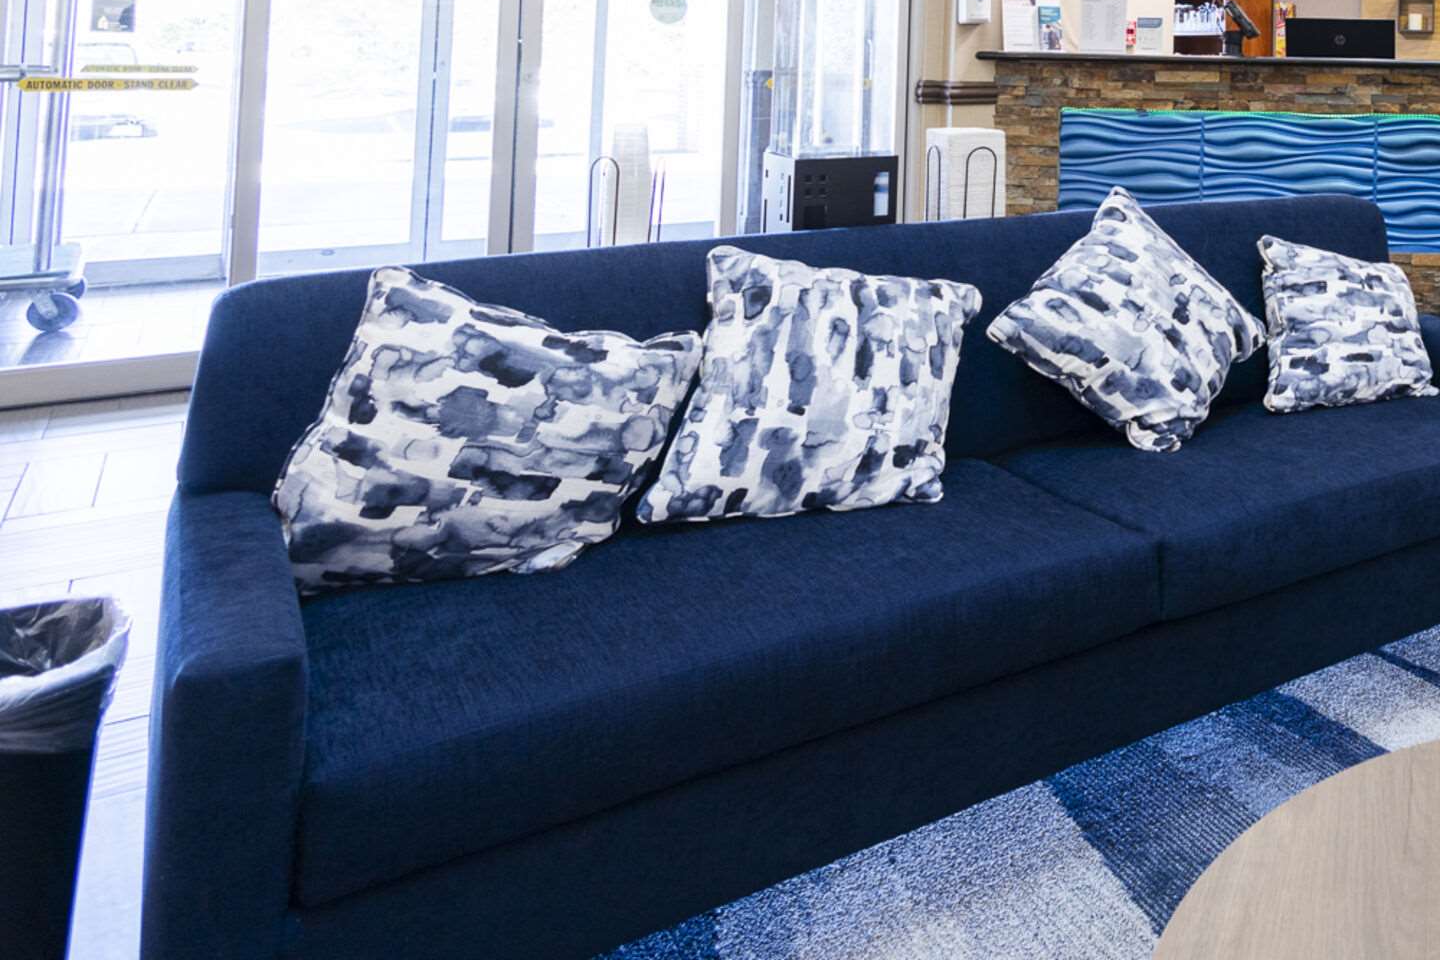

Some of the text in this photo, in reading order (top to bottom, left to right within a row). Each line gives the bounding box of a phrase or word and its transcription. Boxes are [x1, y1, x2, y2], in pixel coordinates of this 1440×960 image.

[26, 80, 188, 90] AUTOMATIC DOOR STAND CLEAR
